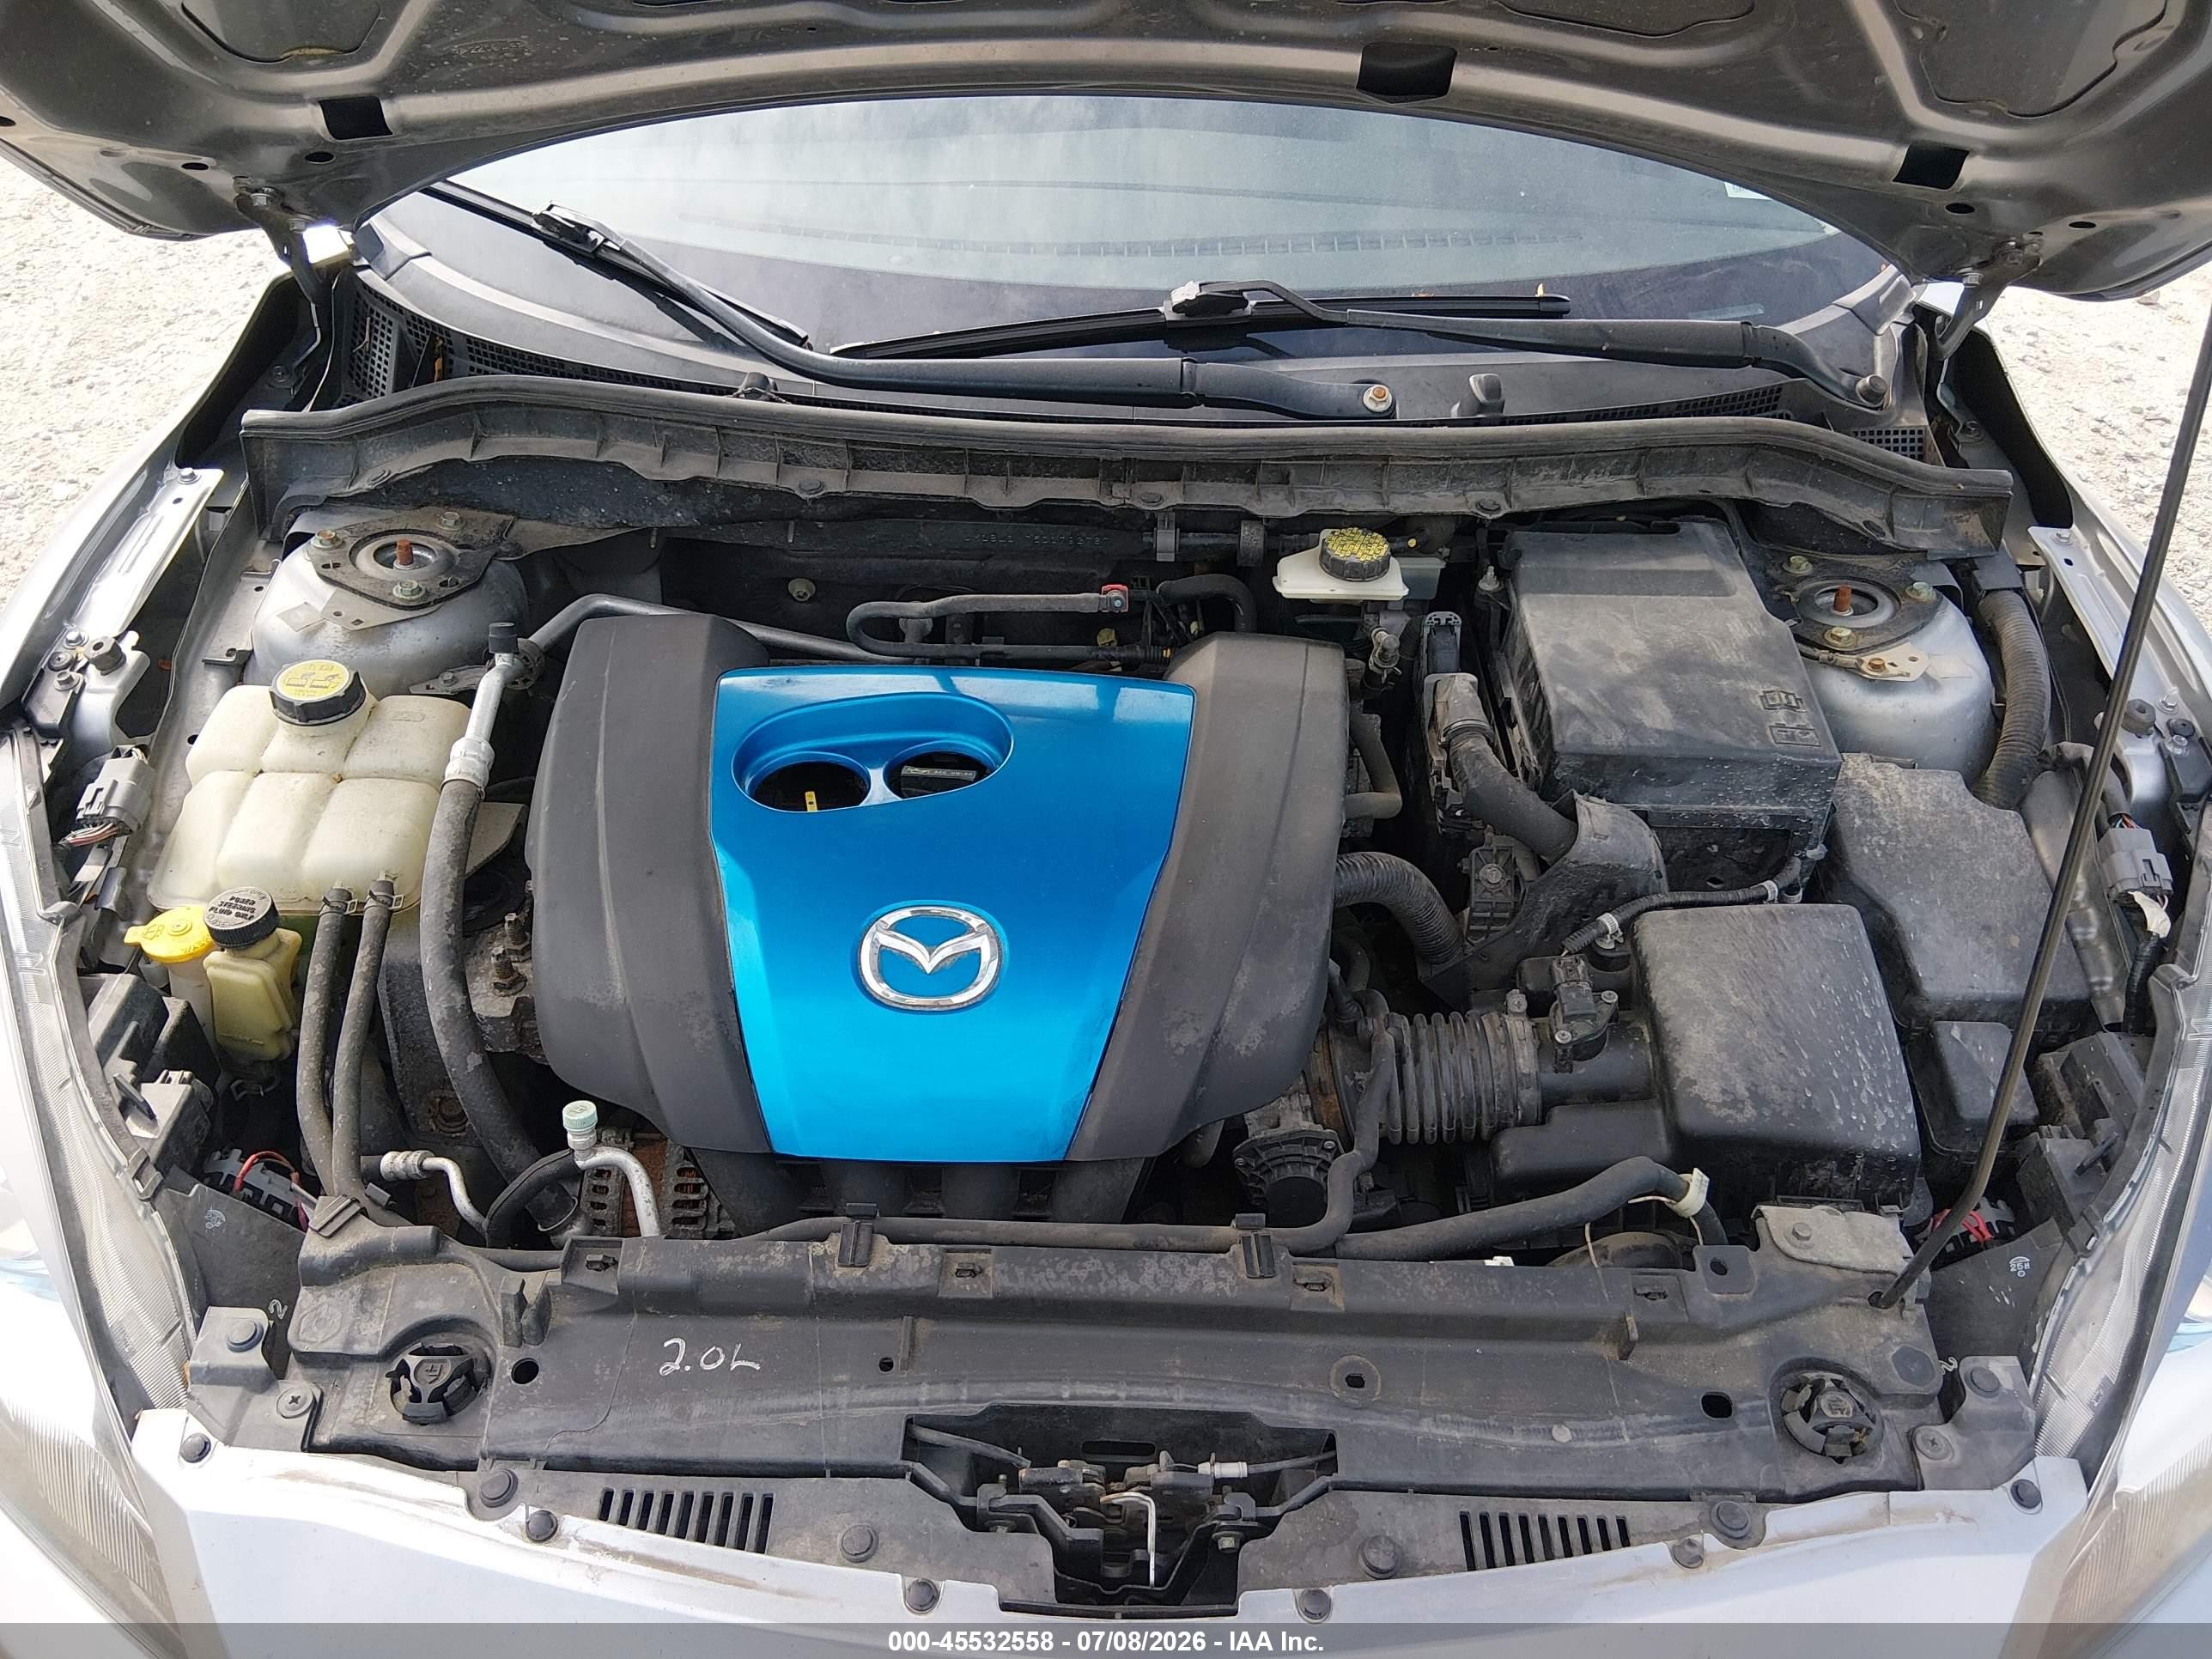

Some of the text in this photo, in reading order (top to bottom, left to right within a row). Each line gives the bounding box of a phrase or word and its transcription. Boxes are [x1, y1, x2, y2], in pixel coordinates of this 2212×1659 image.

[228, 895, 257, 906] POWER
[208, 906, 233, 915] FLUID
[217, 900, 257, 914] STEERING
[659, 1337, 761, 1378] 2.0L
